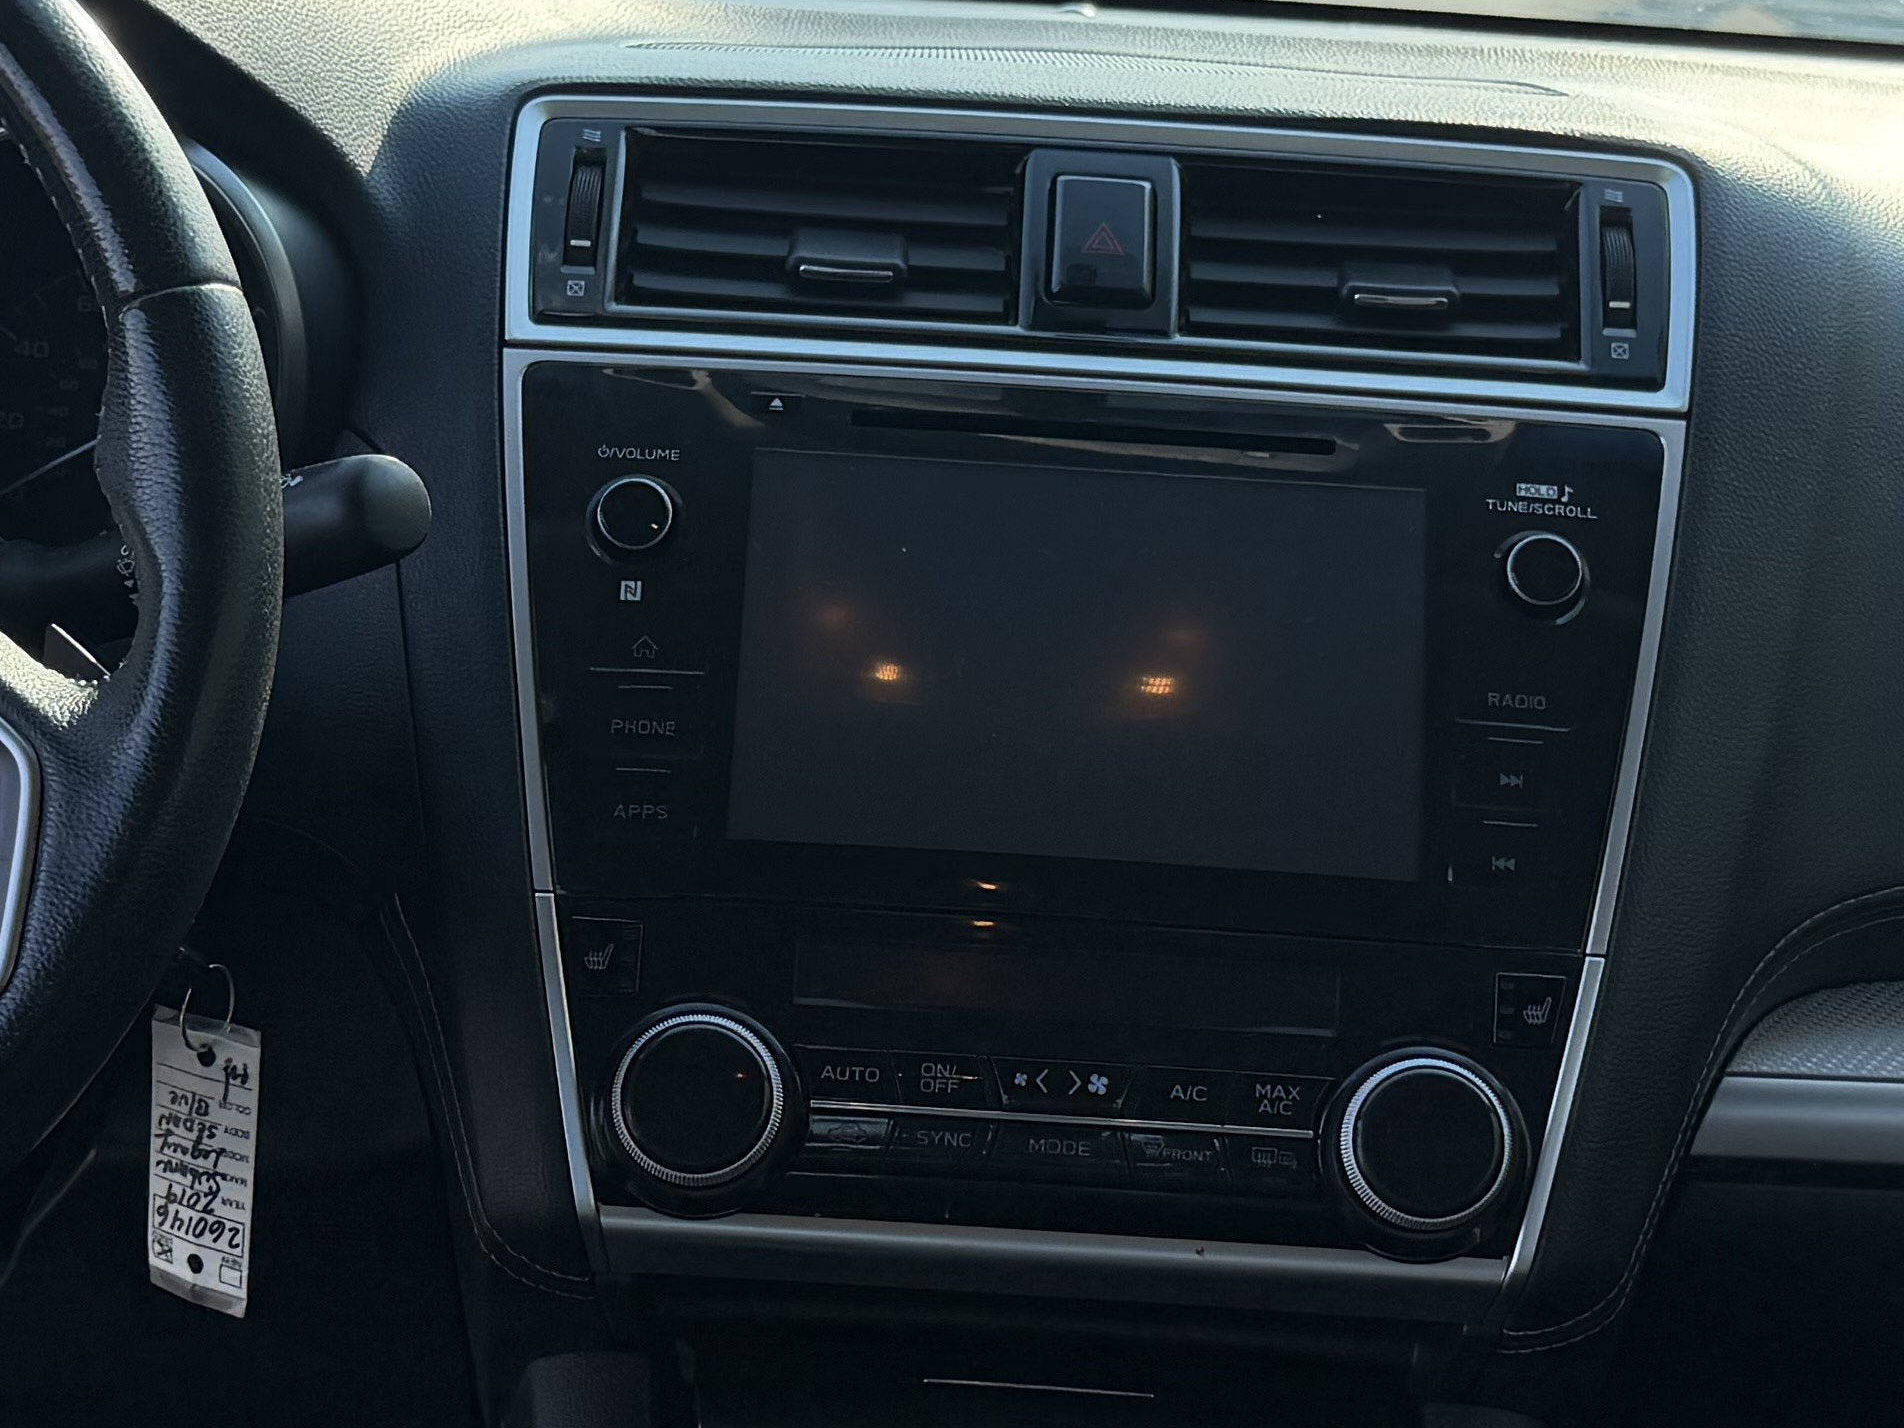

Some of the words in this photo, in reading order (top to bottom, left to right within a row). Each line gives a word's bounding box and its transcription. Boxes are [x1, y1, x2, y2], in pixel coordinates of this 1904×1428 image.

[1485, 498, 1598, 520] TUNE/SCROLL
[1487, 691, 1547, 711] RADIO
[610, 718, 676, 737] PHONE
[613, 803, 668, 820] APPS
[821, 1066, 880, 1083] AUTO
[920, 1079, 960, 1094] OFF
[1170, 1085, 1207, 1101] A/C
[1256, 1084, 1300, 1100] MAX
[1259, 1100, 1294, 1116] A/C
[916, 1131, 972, 1148] SYNC
[1029, 1138, 1091, 1157] MODE
[1161, 1147, 1213, 1163] FRONT
[166, 1183, 216, 1215] 2019
[156, 1203, 241, 1250] 260146
